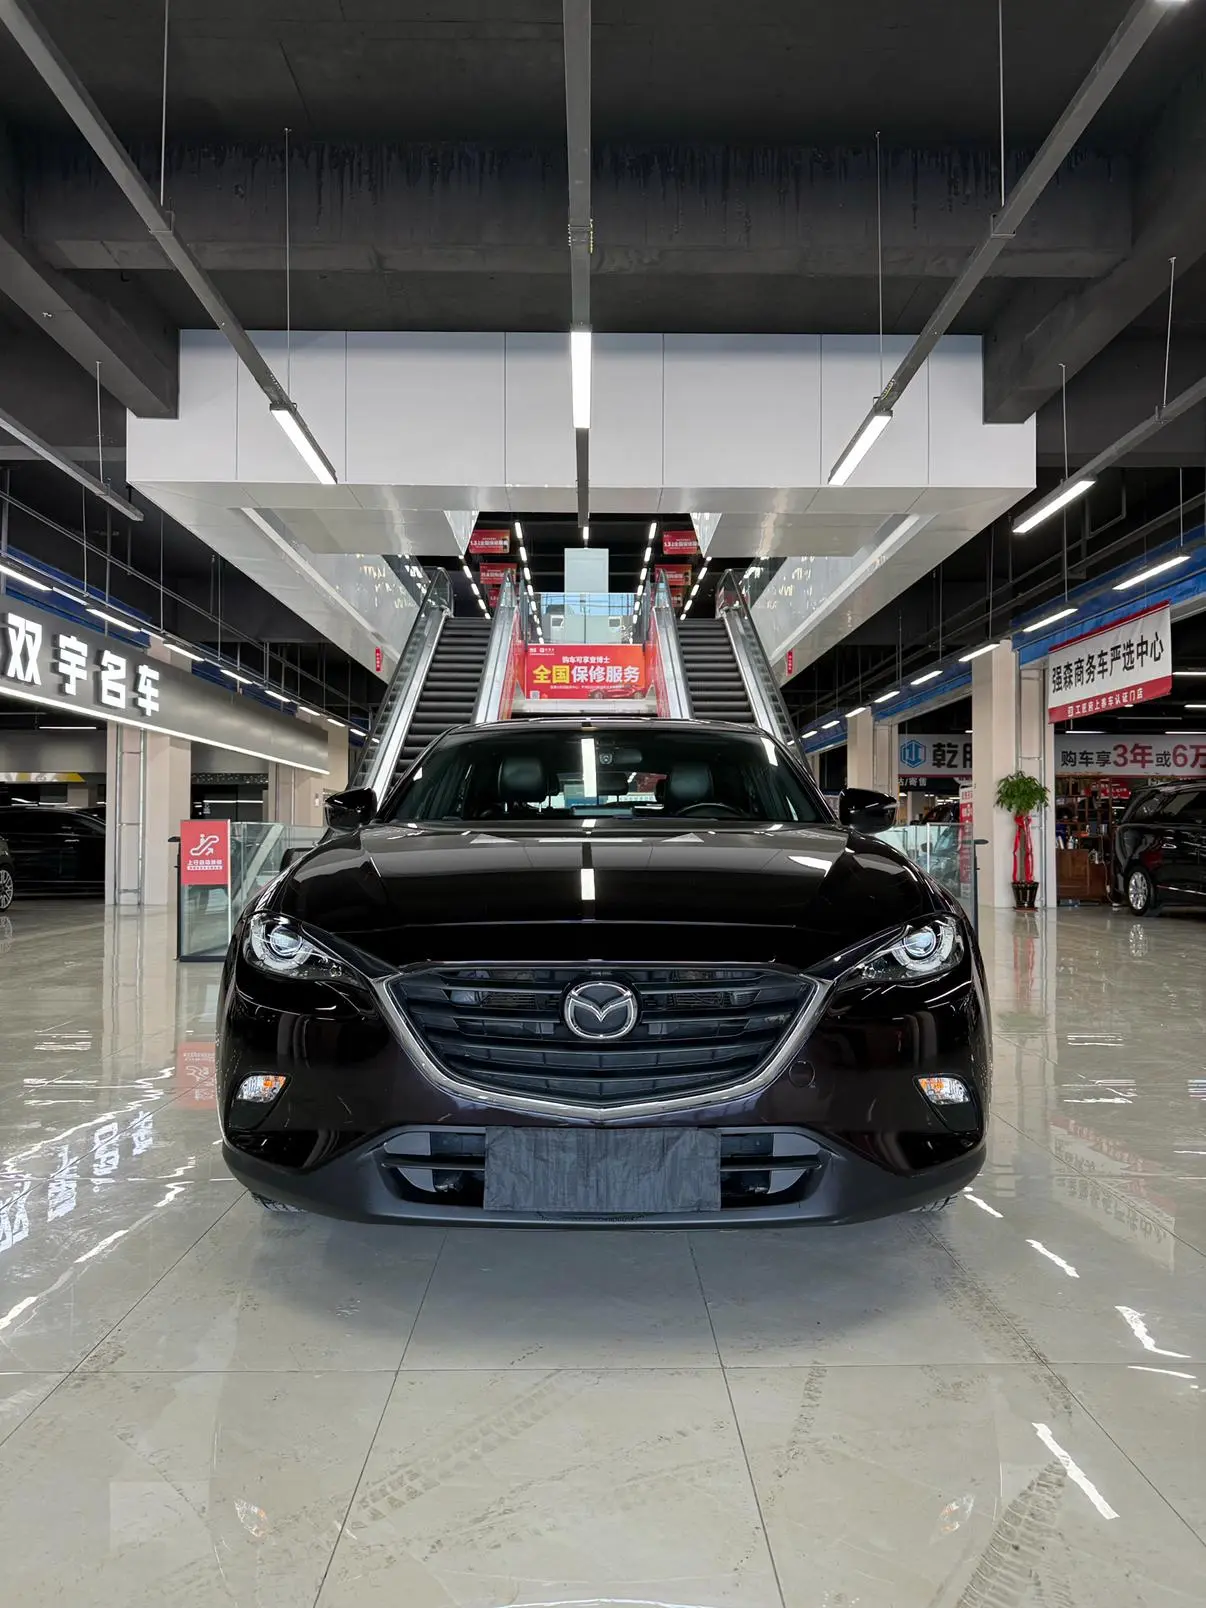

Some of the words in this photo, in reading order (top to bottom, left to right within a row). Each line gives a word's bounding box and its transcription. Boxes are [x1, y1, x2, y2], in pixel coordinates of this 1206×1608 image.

[6, 612, 160, 717] 双宇名车
[532, 664, 640, 684] 全国保修服务
[1052, 631, 1164, 694] 强森商务车严选中心
[1061, 743, 1206, 769] 购车享3年或6万
